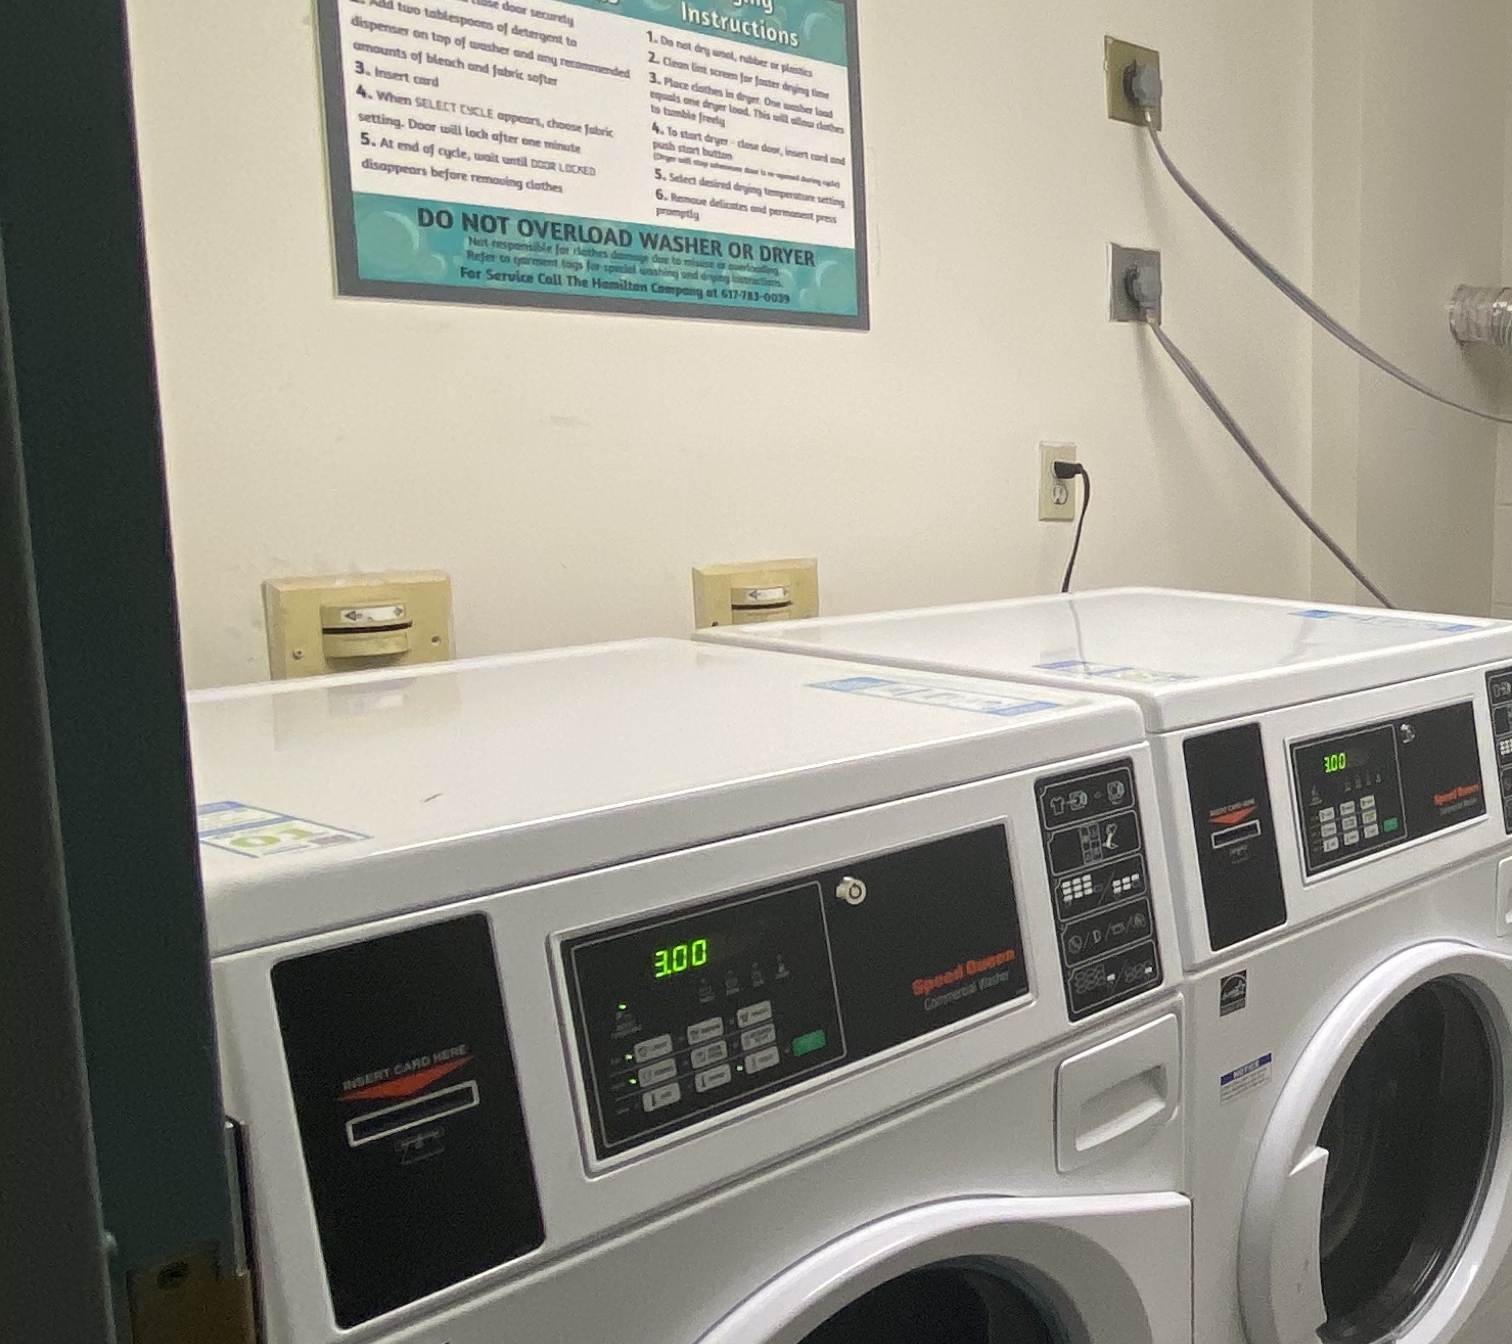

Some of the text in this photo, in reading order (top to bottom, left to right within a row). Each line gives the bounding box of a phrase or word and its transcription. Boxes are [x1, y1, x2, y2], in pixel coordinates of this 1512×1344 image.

[398, 1, 421, 16] two
[425, 7, 493, 31] tablespoons
[498, 23, 508, 36] of
[511, 25, 563, 45] detergent
[566, 36, 577, 48] to
[502, 0, 527, 16] door
[531, 9, 574, 28] securely
[681, 1, 799, 47] Instructions
[351, 15, 409, 36] dispenser
[413, 30, 428, 40] on
[431, 31, 451, 47] top
[455, 37, 466, 50] of
[470, 41, 509, 55] washer
[514, 50, 534, 60] and
[537, 54, 557, 67] any
[353, 43, 557, 86] amounts of bleach and fabric softer
[355, 60, 439, 88] 3. Insert card
[356, 85, 373, 100] 4.
[377, 90, 412, 106] When
[497, 112, 544, 129] appears,
[547, 119, 582, 133] choose
[584, 124, 613, 138] fabric
[358, 113, 581, 153] setting. Door will lock after one minute
[360, 132, 376, 146] 5.
[380, 137, 394, 149] At
[398, 142, 419, 152] end
[423, 144, 435, 157] of
[438, 148, 471, 162] cycle,
[474, 152, 500, 163] wait
[503, 156, 528, 167] until
[361, 158, 427, 176] disappears
[431, 167, 467, 181] before
[471, 175, 523, 191] removing
[417, 208, 815, 266] DO NOT OVERLOAD WASHER OR DRYER
[460, 267, 482, 279] For
[486, 269, 534, 283] Service
[538, 274, 562, 285] Call
[566, 276, 588, 287] The
[592, 278, 647, 292] Hamilton
[651, 283, 703, 299] Company
[706, 288, 717, 297] at
[655, 939, 708, 978] 3.00
[912, 948, 1016, 996] Speed Queen
[342, 1044, 468, 1091] INSERT CARD HERE
